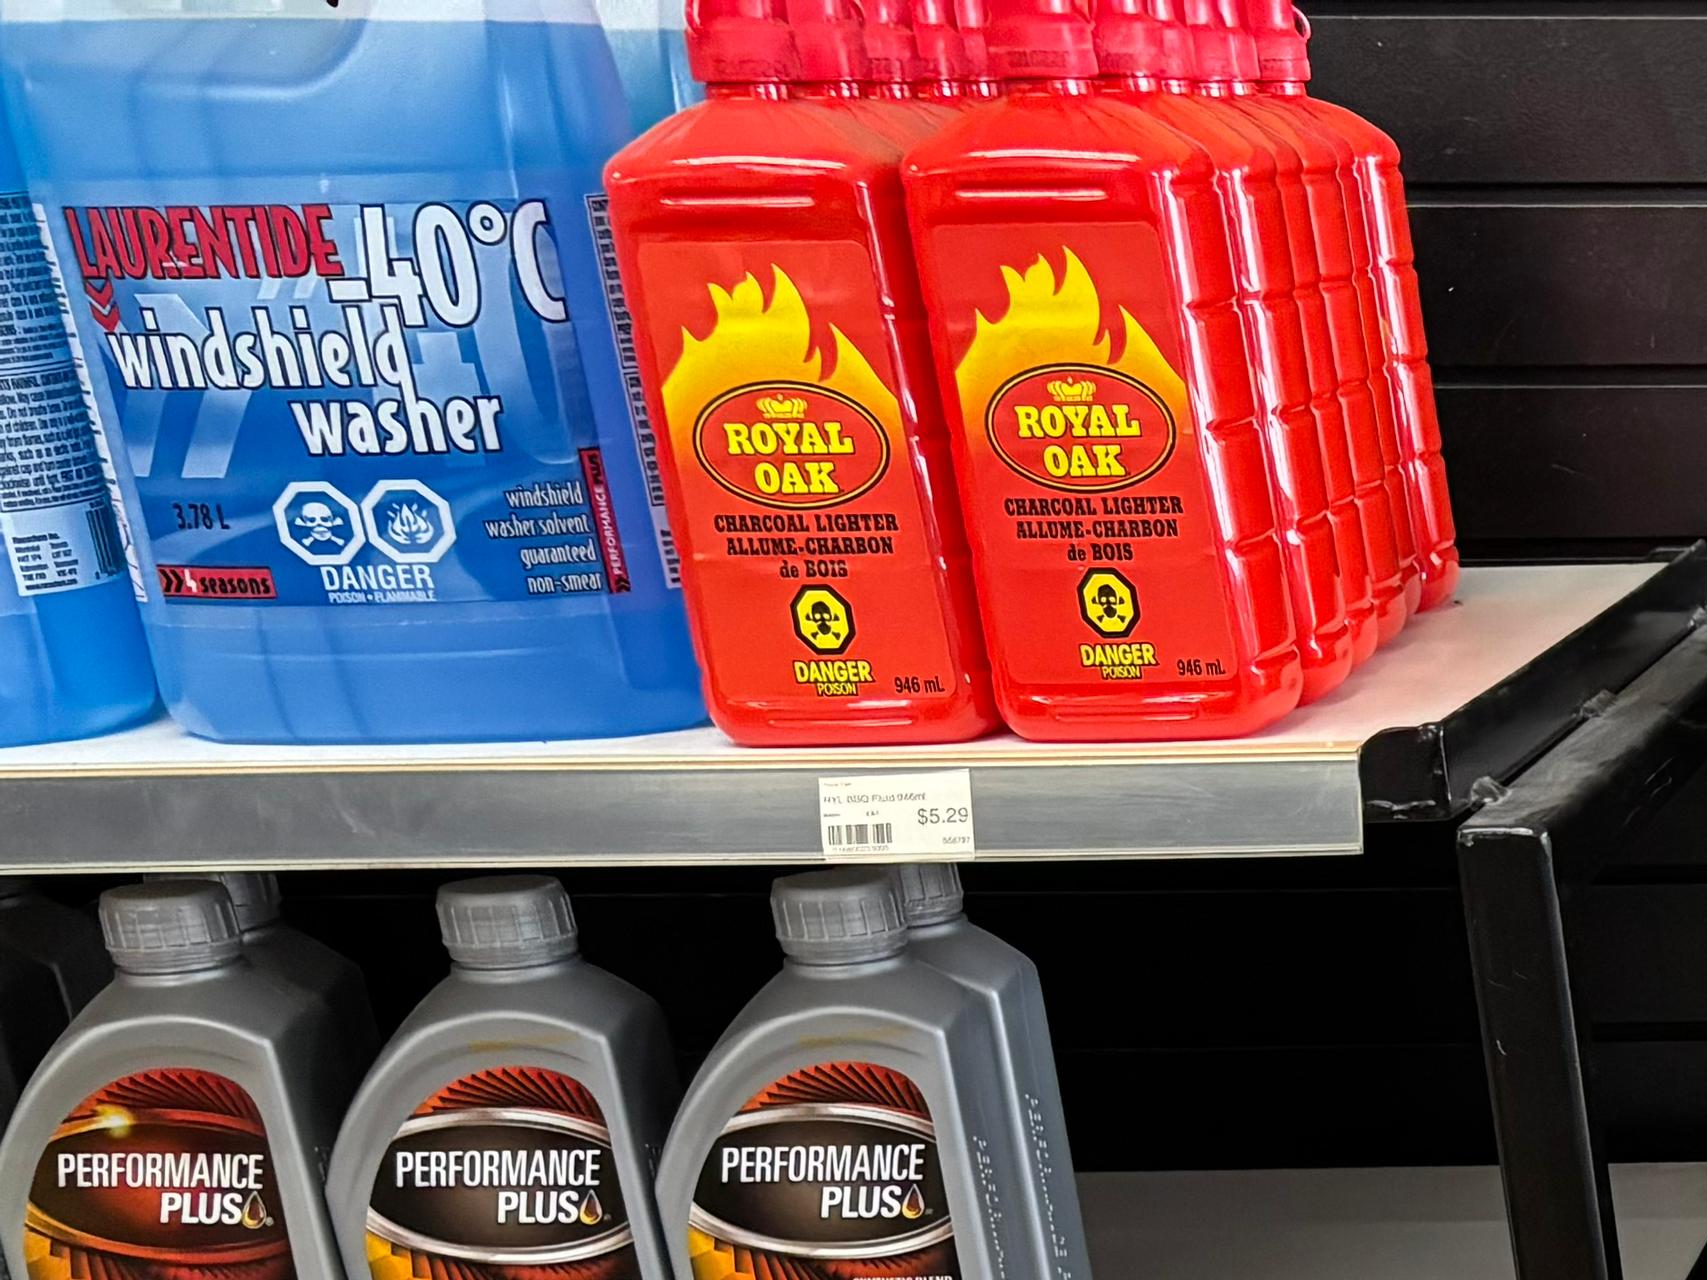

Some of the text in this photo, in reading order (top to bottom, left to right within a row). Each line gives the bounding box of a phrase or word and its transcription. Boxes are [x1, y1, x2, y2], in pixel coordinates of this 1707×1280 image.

[64, 204, 344, 281] LAURENTIDE
[328, 200, 568, 329] -40°C
[106, 297, 406, 390] windshield
[291, 393, 503, 456] washer
[1014, 404, 1142, 438] ROYAL
[724, 421, 854, 455] ROYAL
[1043, 444, 1127, 478] OAK
[754, 461, 840, 495] OAK
[505, 481, 583, 511] windshield
[484, 511, 591, 539] washer solvent
[714, 513, 899, 533] CHARCOAL LIGHTER
[520, 543, 597, 569] guaranteed
[726, 536, 894, 556] ALLUME-CHARBON
[200, 574, 271, 596] seasons
[321, 565, 434, 591] DANGER
[527, 571, 602, 596] non-smear
[780, 560, 848, 579] de BOIS
[794, 660, 873, 683] DANGER
[894, 676, 920, 693] 946
[917, 807, 969, 825] $5.29
[57, 1152, 264, 1190] PERFORMANCE
[396, 1150, 600, 1188] PERFORMANCE
[721, 1144, 925, 1183] PERFORMANCE
[159, 1193, 243, 1225] PLUS
[497, 1190, 579, 1224] PLUS
[821, 1184, 902, 1220] PLUS
